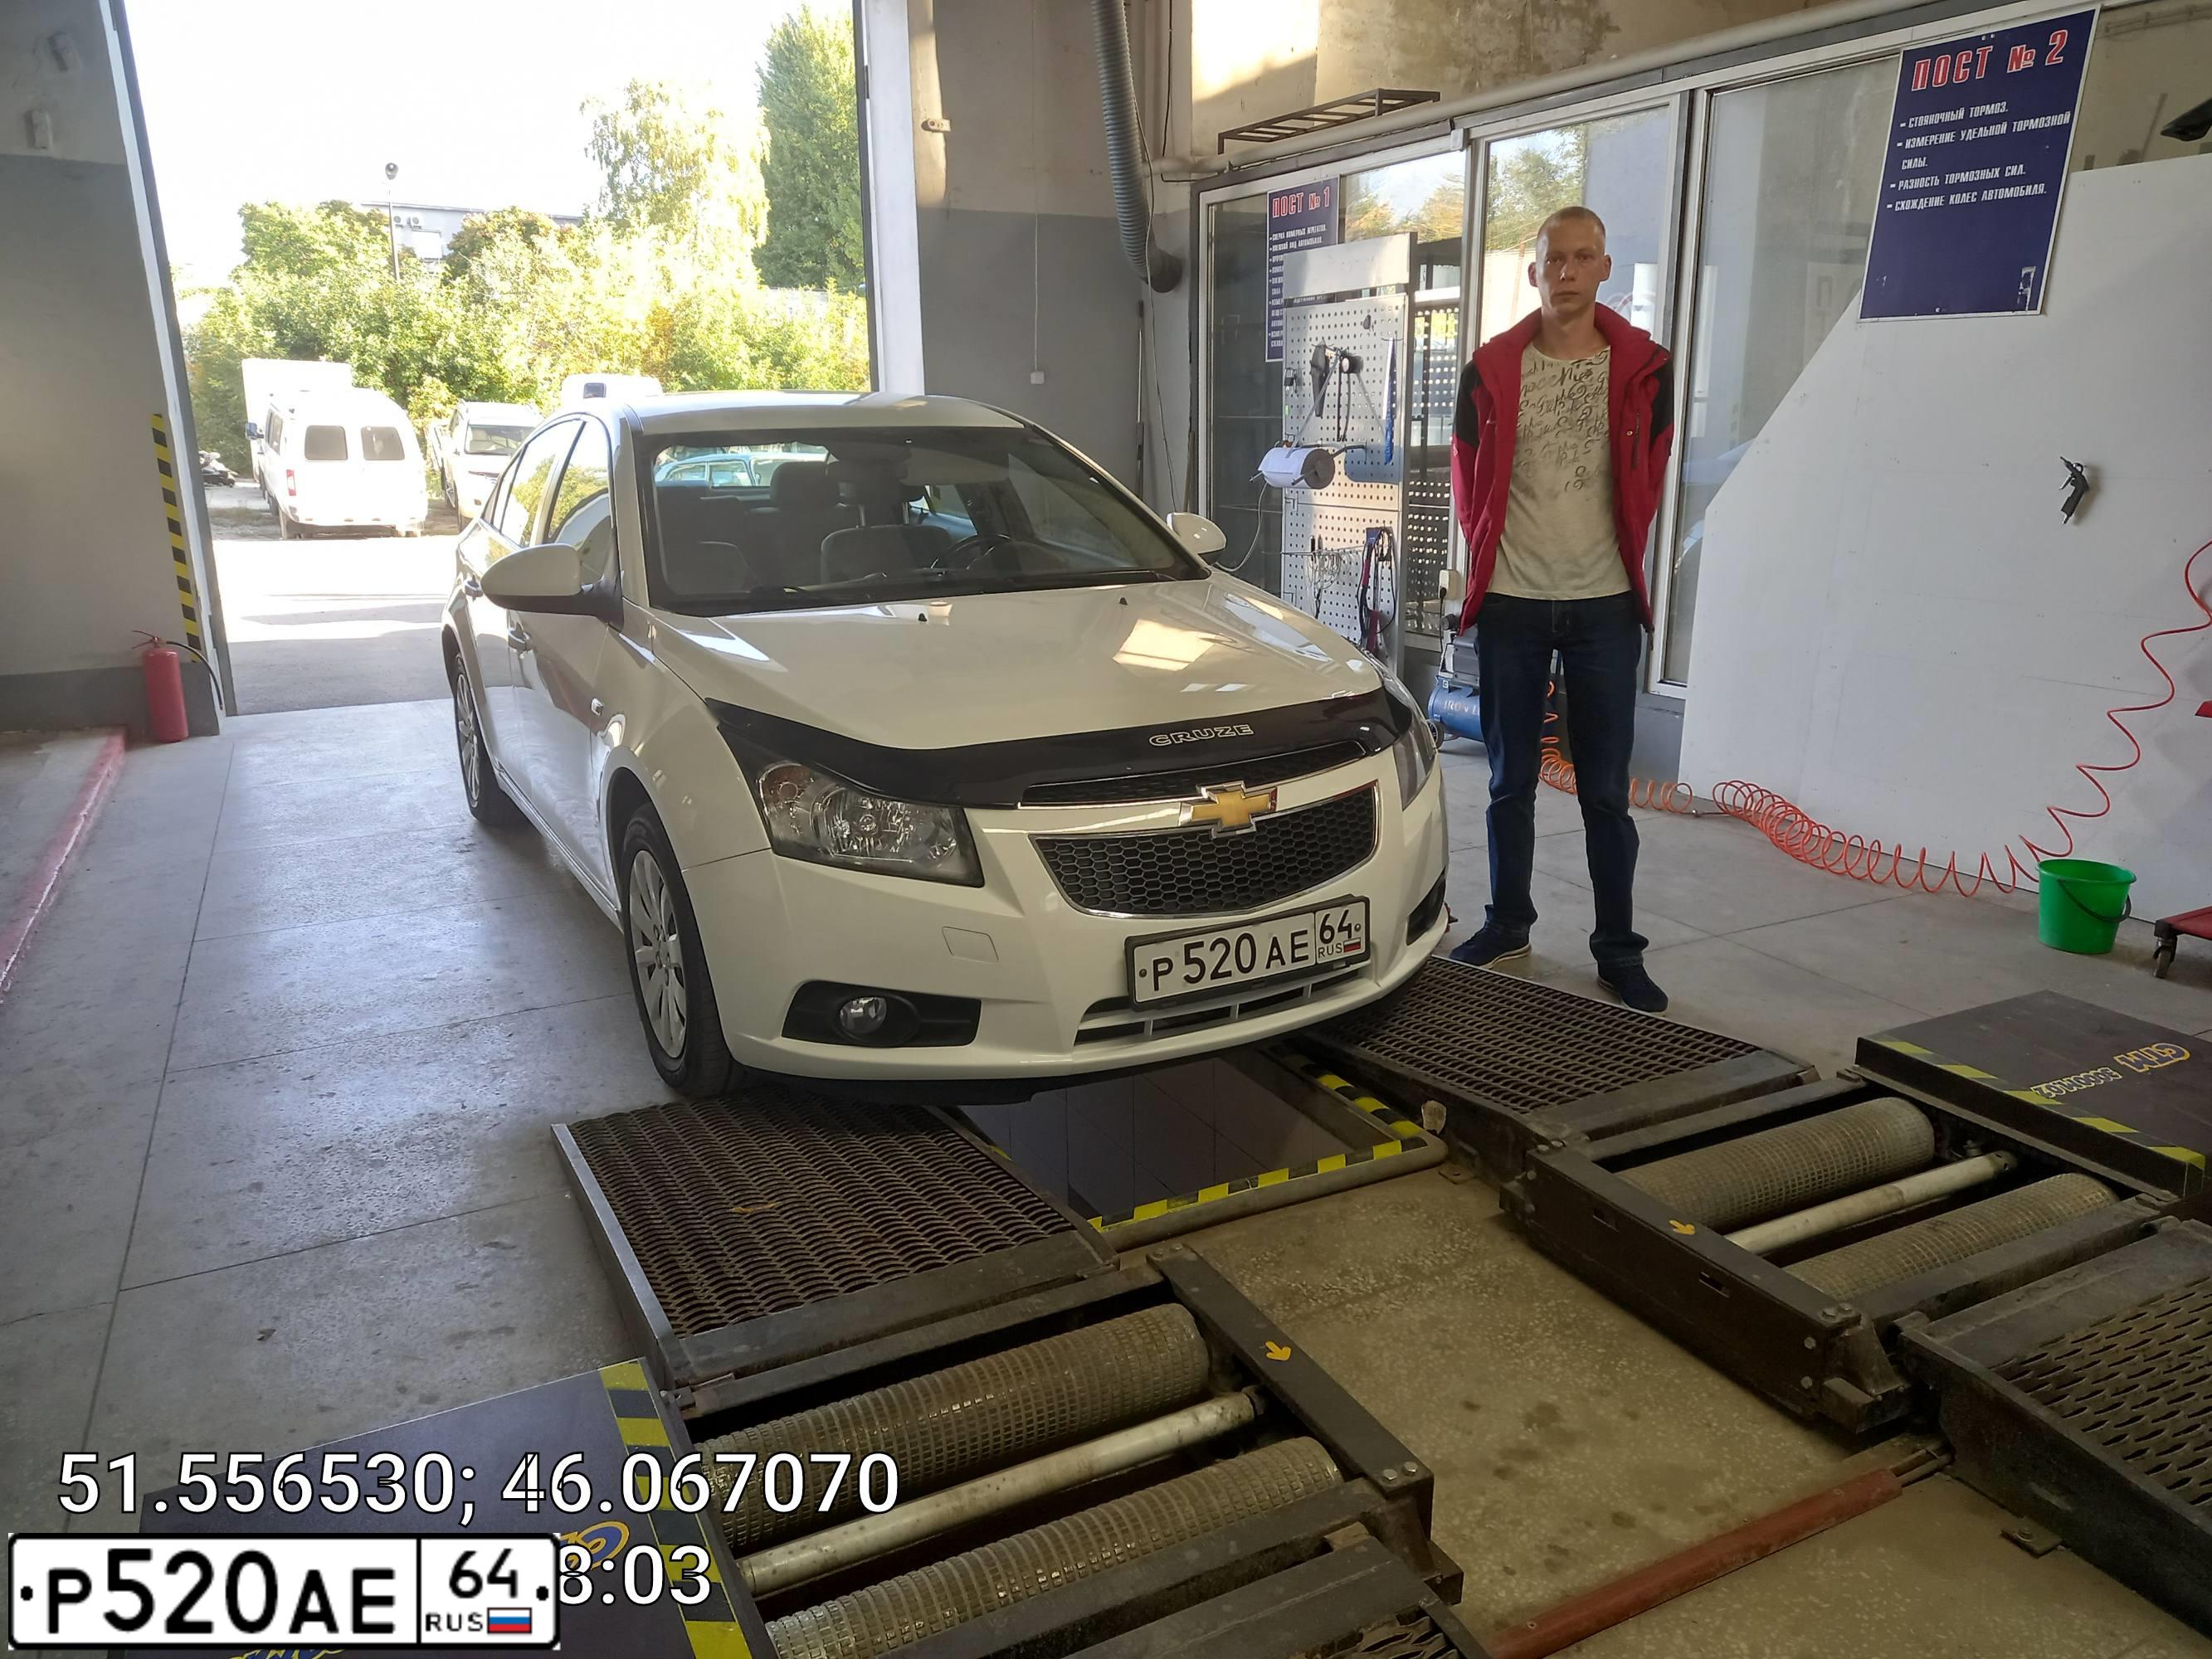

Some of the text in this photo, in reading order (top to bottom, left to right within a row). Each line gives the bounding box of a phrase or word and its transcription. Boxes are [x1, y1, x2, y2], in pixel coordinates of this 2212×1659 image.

[1912, 29, 2068, 91] ПОСТ № 2
[1908, 107, 1966, 129] СТОЯНОЧНЫЙ
[1970, 101, 2009, 118] ТОРМОЗ.
[1905, 131, 1956, 149] ИЗМЕРЕНИЕ
[1960, 120, 2007, 142] УДЕЛЬНОЙ
[2012, 111, 2071, 134] ТОРМОЗНОЙ
[1898, 176, 1940, 191] РАЗНОСТЬ
[1945, 168, 2000, 186] ТОРМОЗНЫХ
[2005, 163, 2026, 178] СИЛ.
[1902, 156, 1928, 170] СИЛЫ.
[1272, 186, 1331, 218] ПОСТ № 1
[1894, 195, 1945, 212] СХОЖДЕНИЕ
[1949, 191, 1977, 206] КОЛЕС
[1981, 182, 2047, 202] АВТОМОБИЛЯ.
[1149, 724, 1255, 747] CRUZE
[1319, 909, 1353, 945] 64
[1318, 942, 1342, 958] RUS
